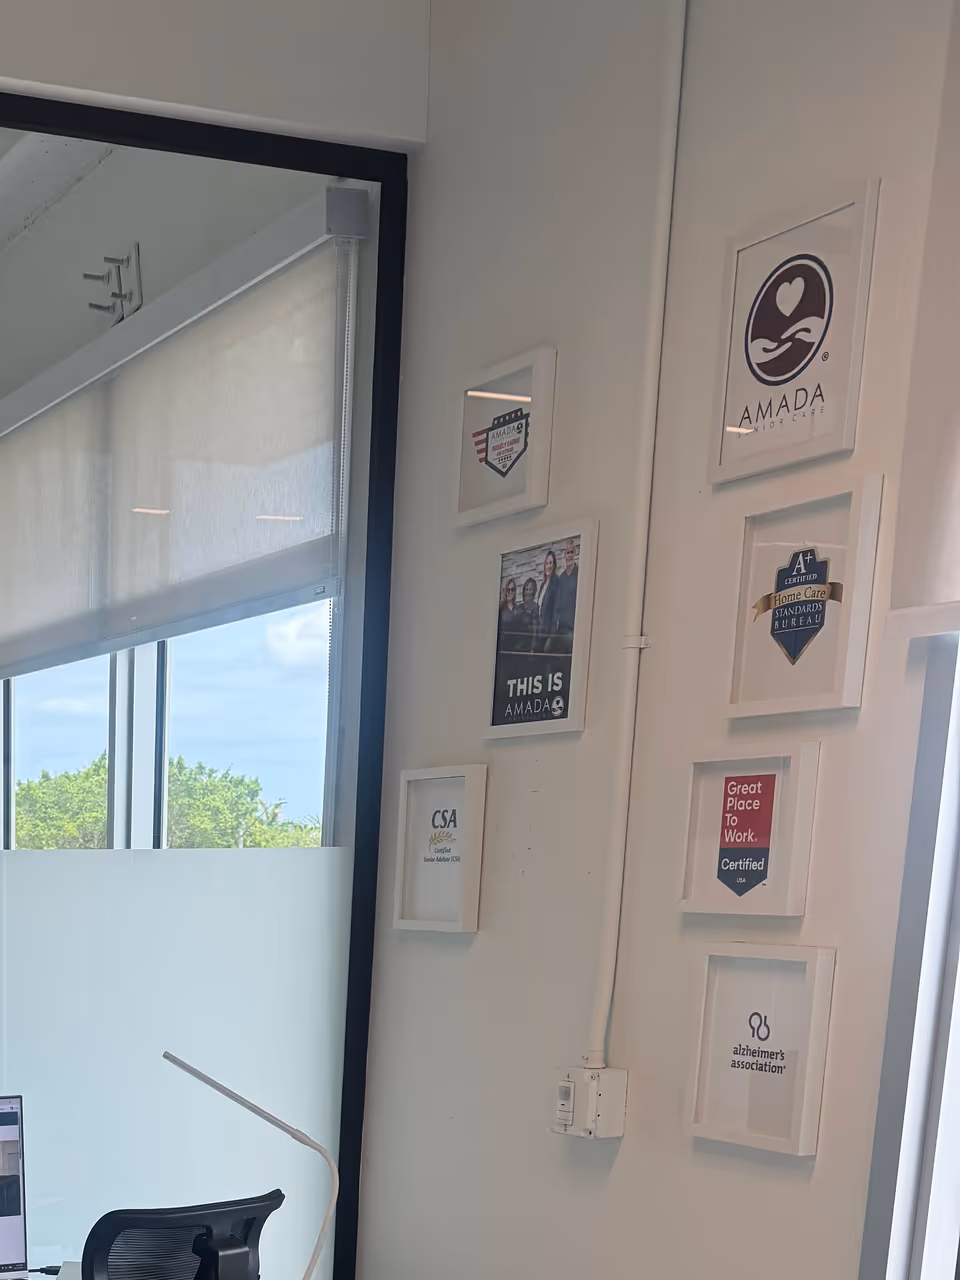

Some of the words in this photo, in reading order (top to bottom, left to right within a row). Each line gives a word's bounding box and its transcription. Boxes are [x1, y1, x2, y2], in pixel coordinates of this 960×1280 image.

[738, 382, 825, 428] AMADA
[792, 405, 825, 422] CARE
[492, 425, 516, 440] AMADA
[792, 551, 813, 575] A+
[784, 573, 818, 585] CERTIFIED
[774, 590, 802, 607] Home
[804, 586, 826, 600] Care
[775, 601, 823, 618] STANDARDS
[774, 613, 822, 629] BUREAU
[507, 674, 543, 698] THIS
[547, 671, 563, 692] IS
[504, 697, 551, 717] AMADA
[727, 781, 762, 795] Great
[726, 797, 760, 811] Place
[432, 809, 457, 829] CSA
[725, 813, 738, 827] To
[721, 858, 765, 870] Certified
